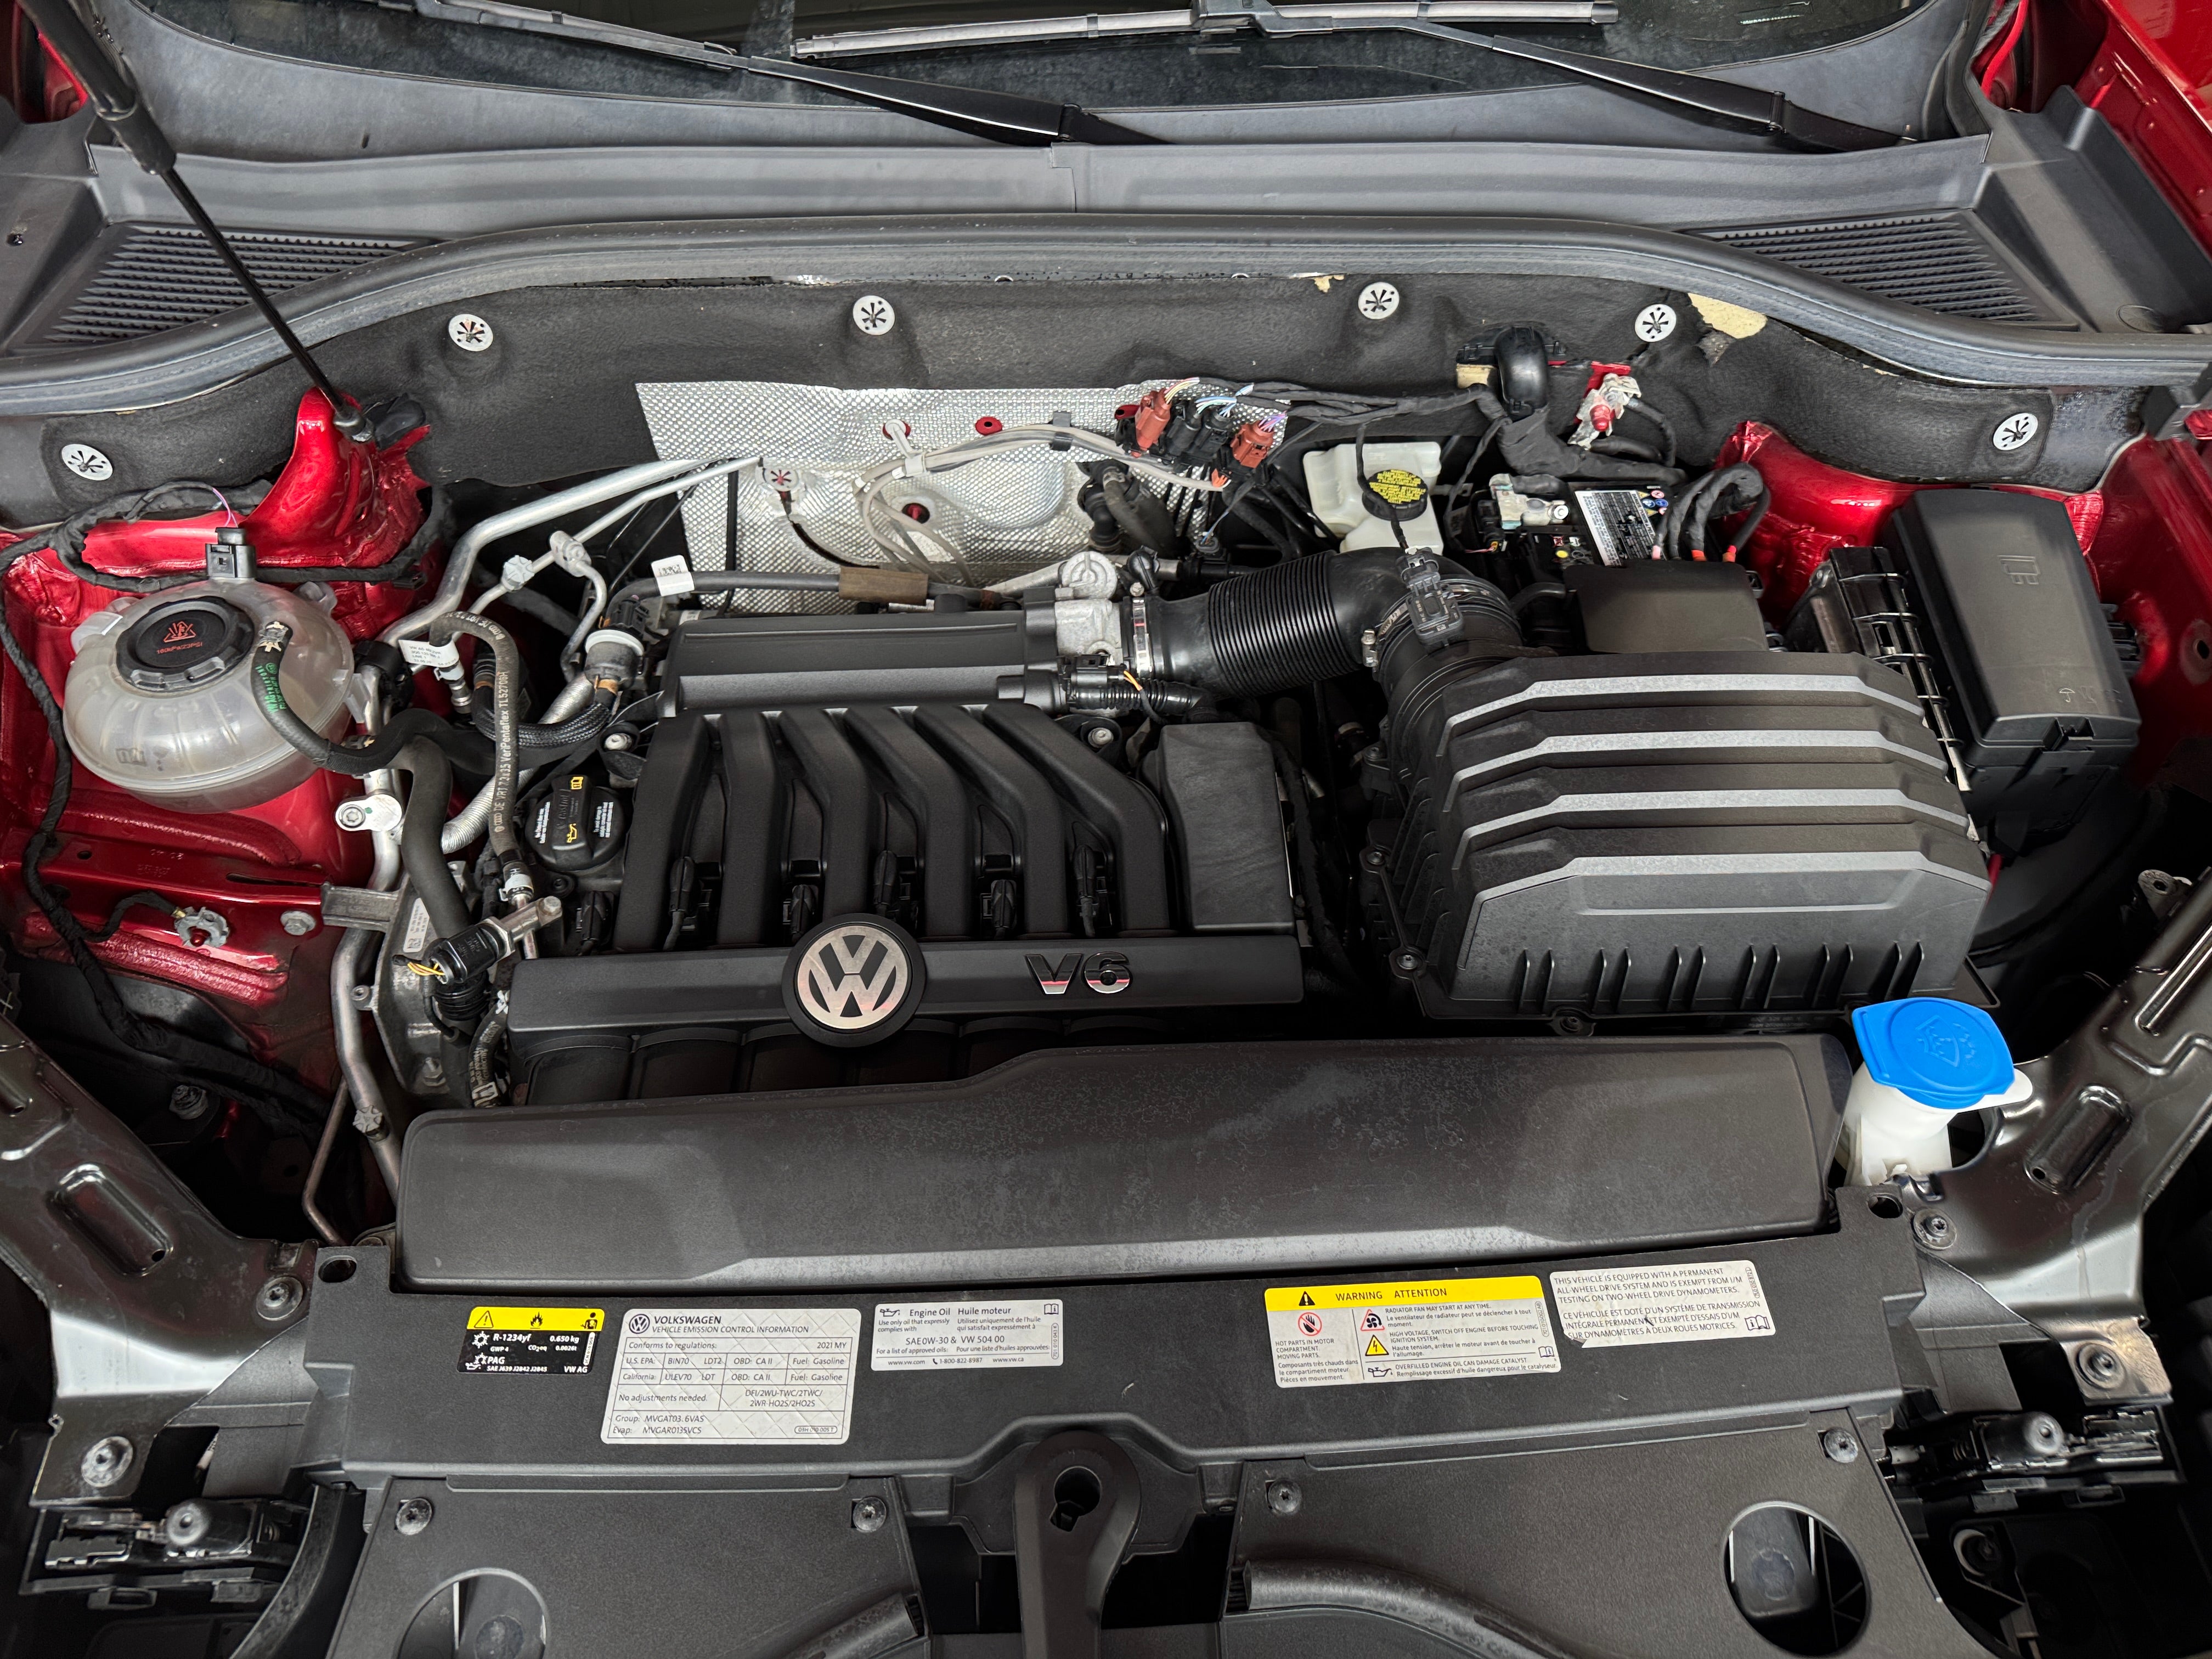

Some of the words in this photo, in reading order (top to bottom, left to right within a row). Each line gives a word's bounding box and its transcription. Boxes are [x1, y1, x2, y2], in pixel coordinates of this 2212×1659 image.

[1025, 951, 1132, 995] V6
[1571, 1275, 1602, 1283] VEHICLE
[1612, 1272, 1650, 1282] EQUIPPED
[1679, 1268, 1723, 1277] PERMANENT
[1395, 1288, 1447, 1298] ATTENTION
[1557, 1285, 1598, 1294] ALL-WHEEL
[1335, 1291, 1383, 1301] WARNING
[1558, 1295, 1590, 1304] TESTING
[1605, 1291, 1652, 1300] TWO-WHEEL
[910, 1309, 937, 1318] Engine
[1644, 1307, 1663, 1316] D'UN
[1706, 1301, 1760, 1310] TRANSMISSION
[1690, 1313, 1720, 1321] D'ESSAIS
[652, 1326, 681, 1334] VEHICLE
[1652, 1325, 1673, 1334] DEUX
[493, 1334, 531, 1344] R-1234yf
[629, 1341, 663, 1351] Conforms
[674, 1341, 716, 1351] regulations:
[813, 1357, 844, 1365] Gasoline
[623, 1373, 656, 1381] California:
[731, 1373, 750, 1381] OBD:
[791, 1373, 808, 1382] Fuel:
[811, 1373, 843, 1382] Gasoline
[618, 1394, 629, 1403] No
[631, 1393, 676, 1403] adjustments
[615, 1414, 641, 1424] Group:
[612, 1426, 632, 1436] Evap:
